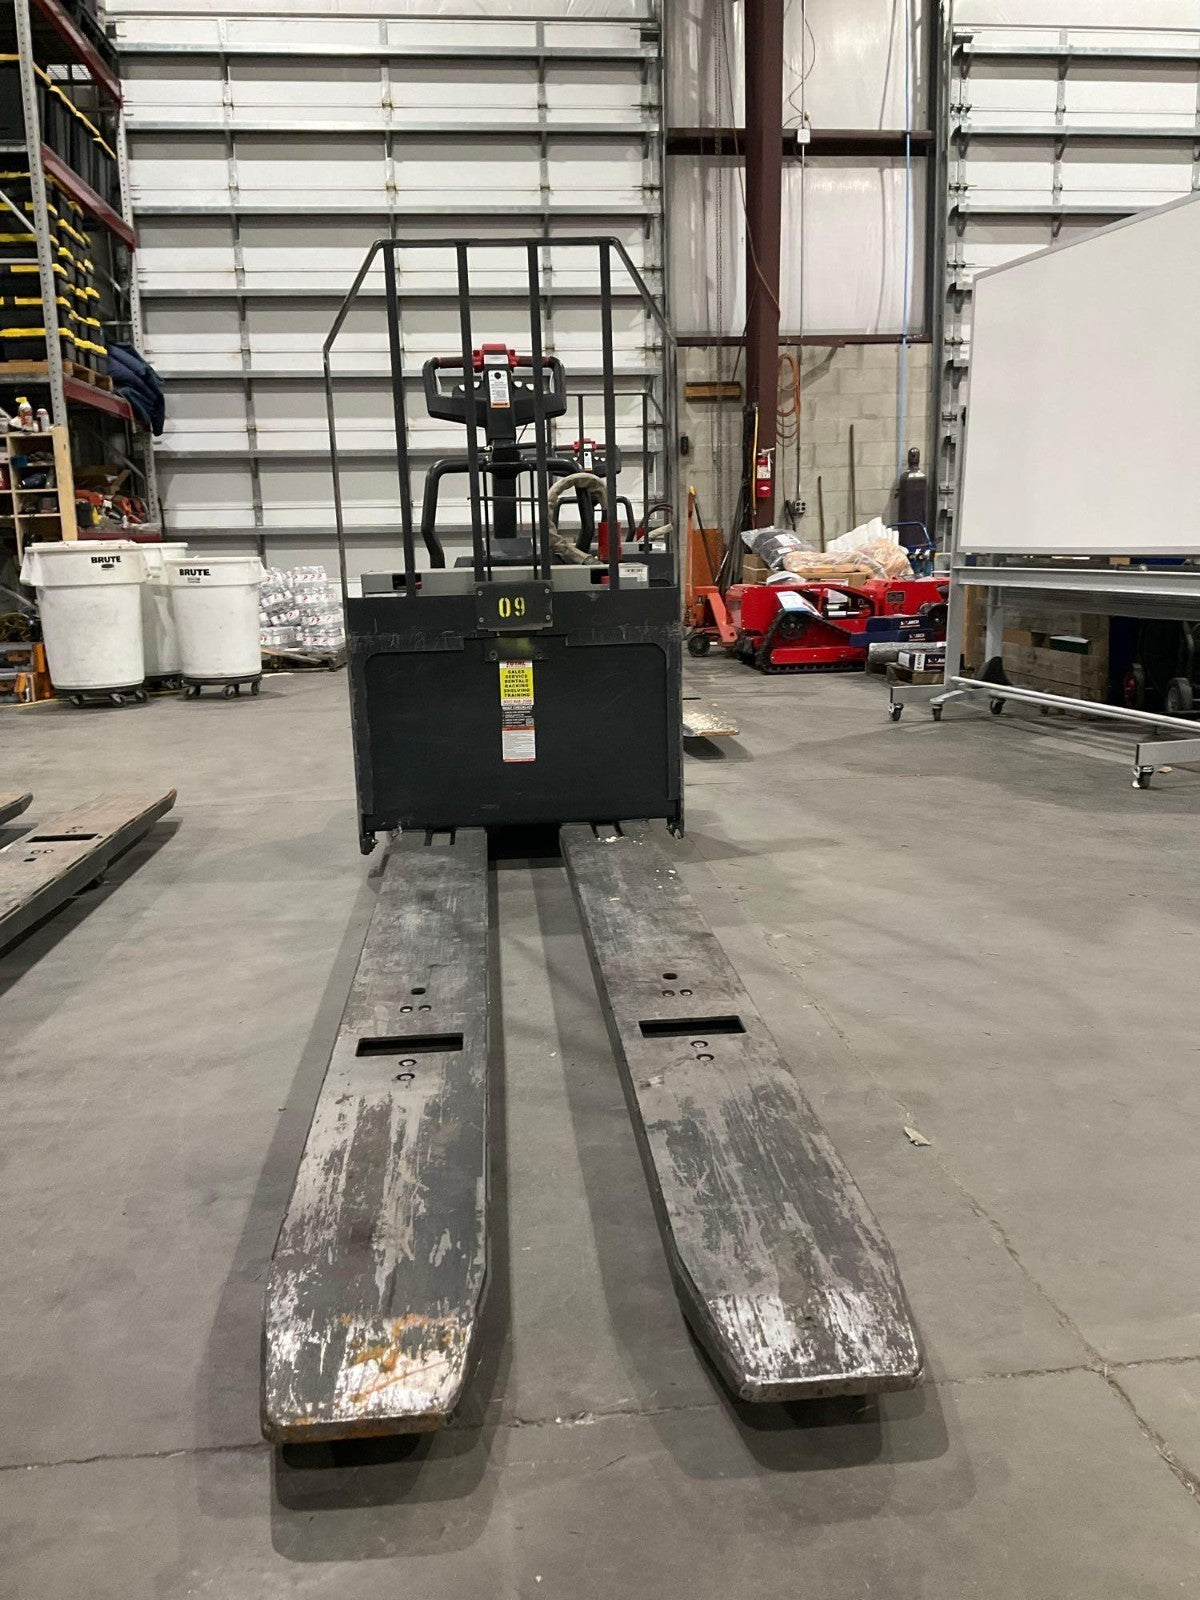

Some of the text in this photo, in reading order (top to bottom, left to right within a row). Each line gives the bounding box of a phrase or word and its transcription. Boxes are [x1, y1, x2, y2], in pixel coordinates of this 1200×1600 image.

[91, 555, 121, 563] BRUTE
[179, 568, 211, 576] BRUTE
[498, 597, 525, 617] 09
